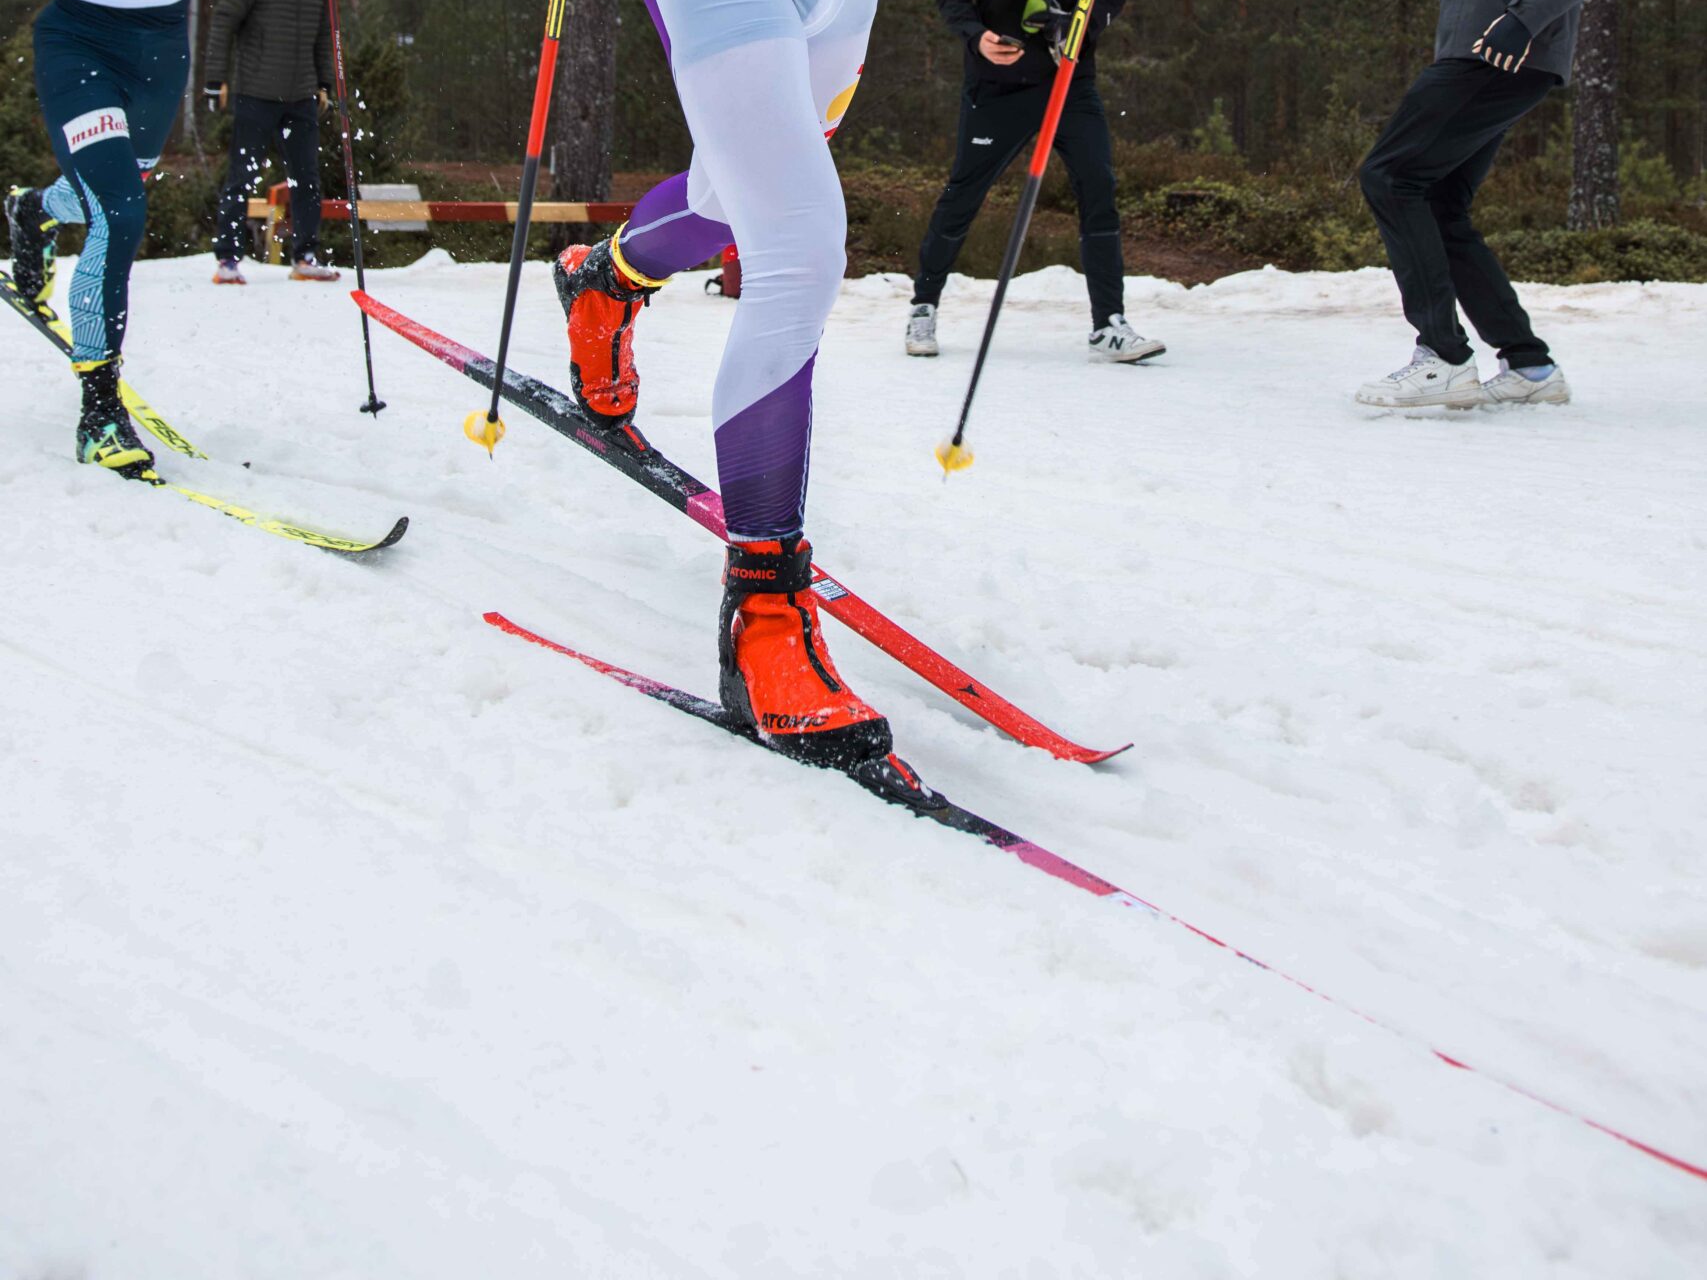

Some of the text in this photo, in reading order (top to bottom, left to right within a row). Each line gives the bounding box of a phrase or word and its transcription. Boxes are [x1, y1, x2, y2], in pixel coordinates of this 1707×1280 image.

[575, 427, 608, 455] ATOMIC
[730, 566, 777, 581] ATOMIC
[761, 712, 830, 729] ATOMIC
